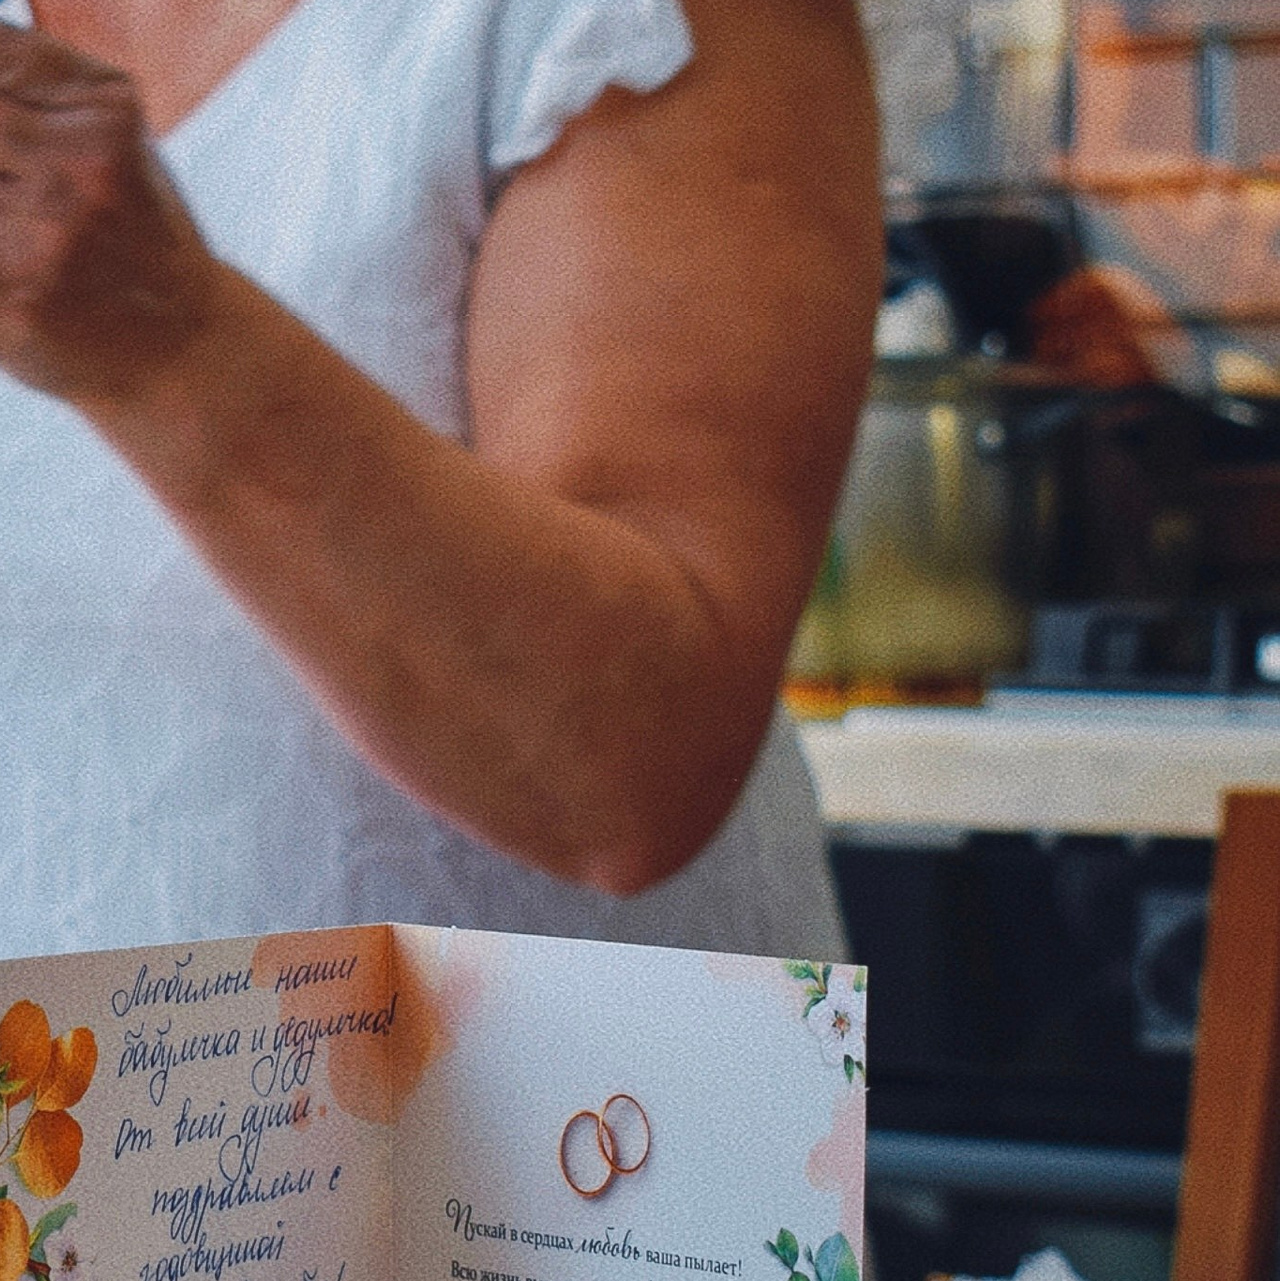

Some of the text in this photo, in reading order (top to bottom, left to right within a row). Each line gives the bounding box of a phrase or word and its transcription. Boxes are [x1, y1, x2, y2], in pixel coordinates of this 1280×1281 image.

[112, 952, 358, 1017] Любимые наши
[118, 1018, 241, 1107] бабулечка
[252, 1025, 267, 1053] и
[174, 1097, 226, 1147] всей
[219, 1096, 312, 1183] души
[151, 1168, 315, 1244] поздравляем
[445, 1198, 742, 1278] Пускай в сердцах любовь ваша пылает!
[451, 1260, 478, 1281] Всю
